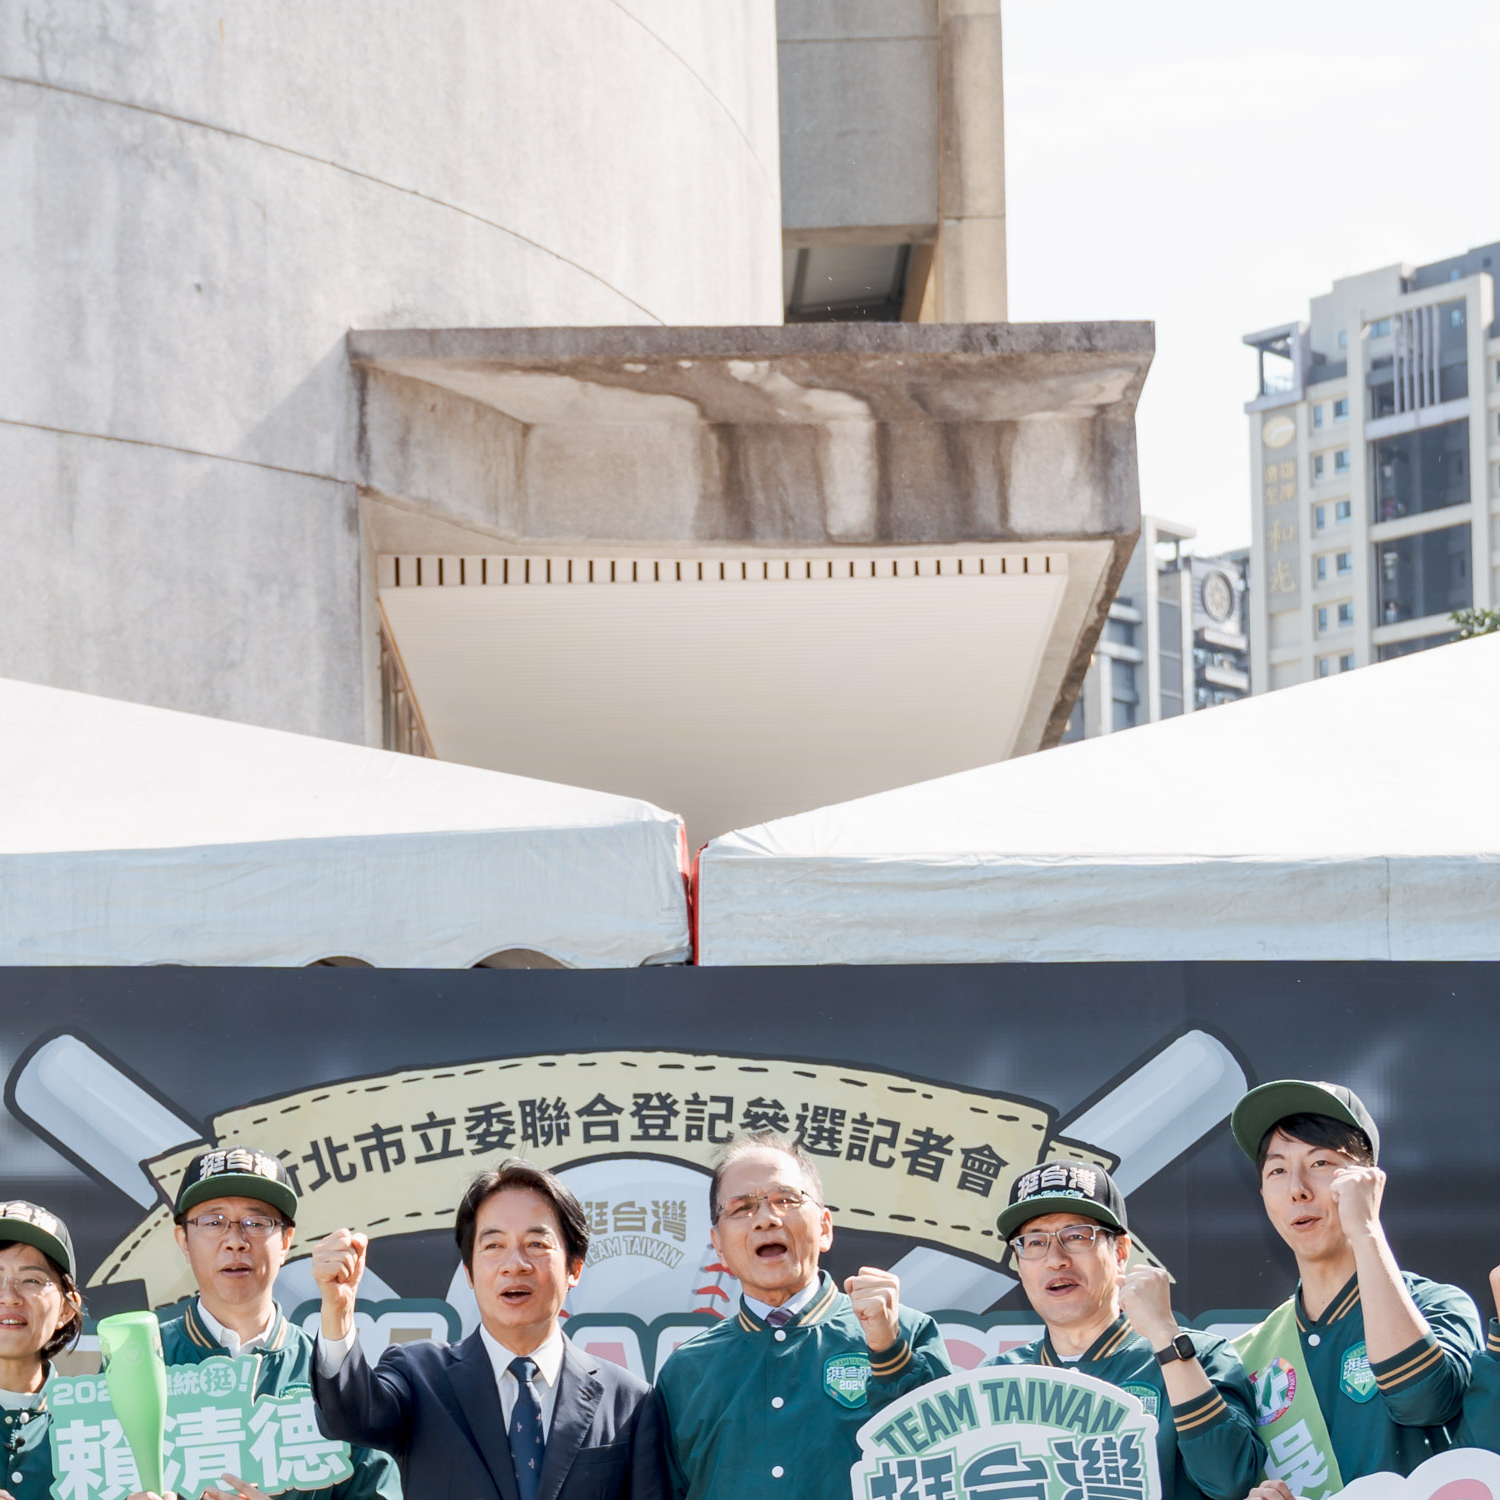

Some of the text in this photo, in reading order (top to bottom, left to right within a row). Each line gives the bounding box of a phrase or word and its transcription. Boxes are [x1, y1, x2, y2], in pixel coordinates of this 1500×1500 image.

[622, 1235, 684, 1270] TAIWAN
[839, 1380, 865, 1391] 2024
[871, 1384, 981, 1456] TEAM
[979, 1377, 1130, 1435] TAIWAN
